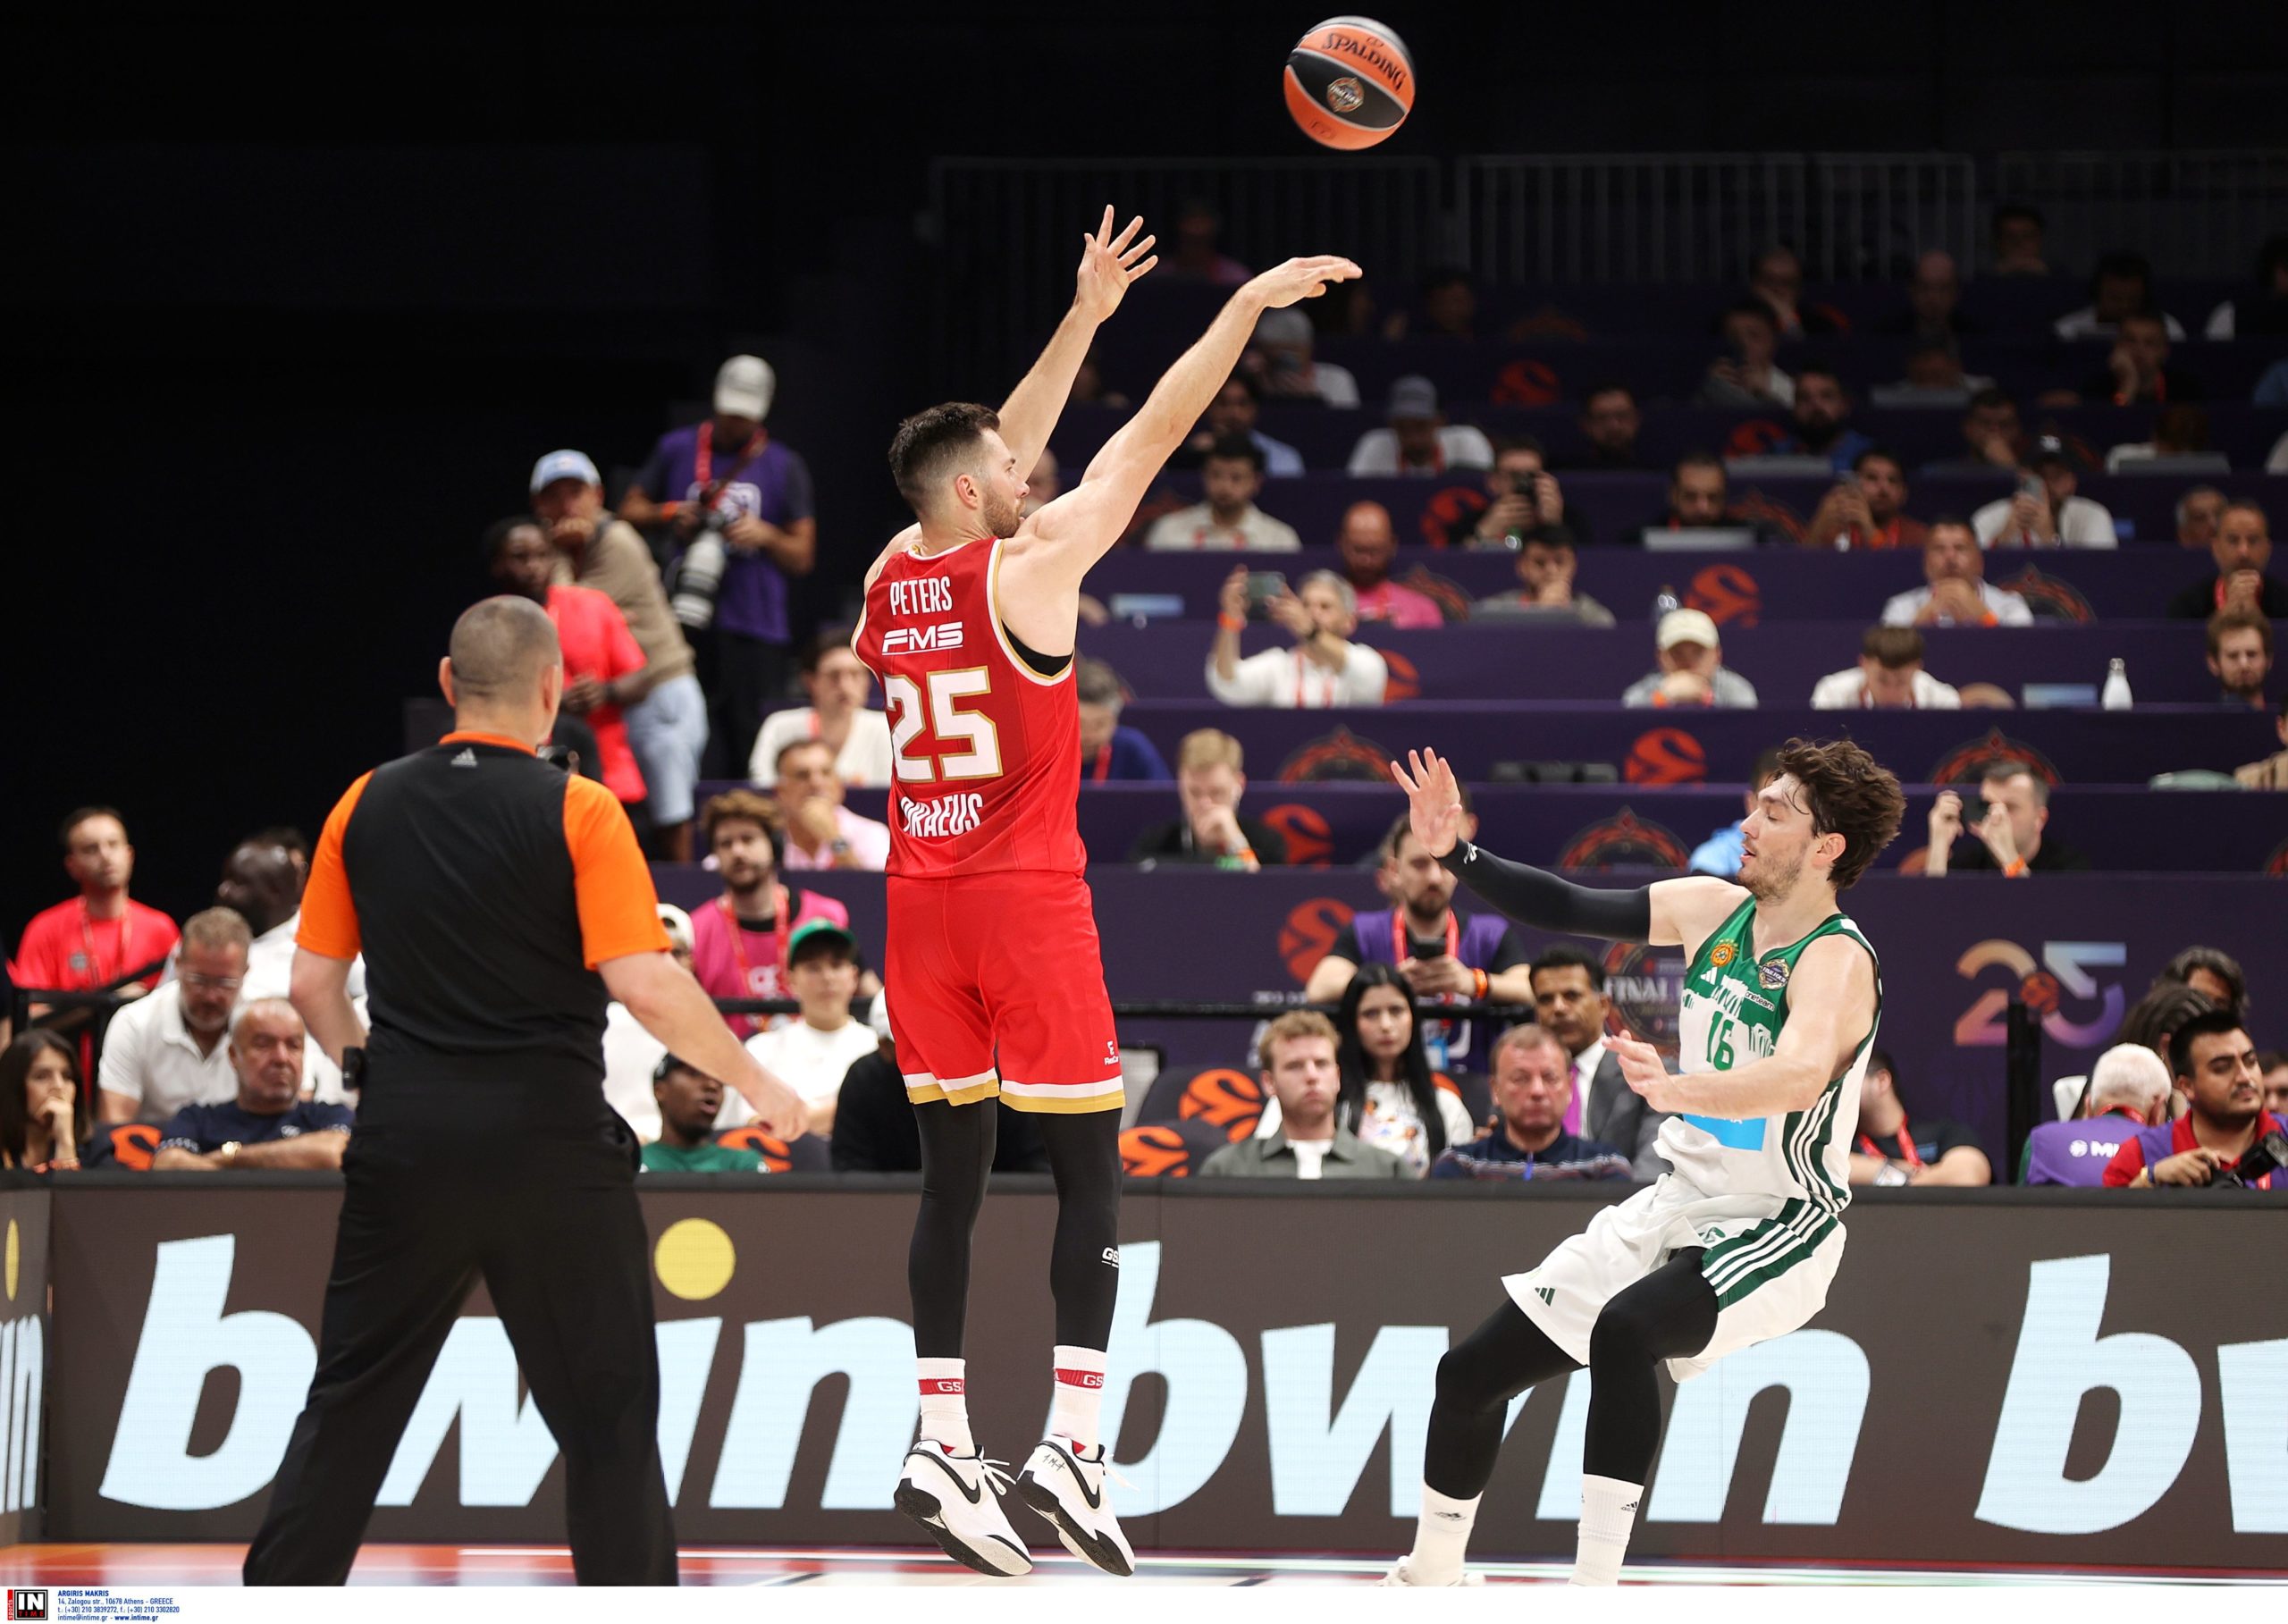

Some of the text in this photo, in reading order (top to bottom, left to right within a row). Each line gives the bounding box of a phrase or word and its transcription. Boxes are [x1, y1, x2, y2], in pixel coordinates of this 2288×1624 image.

[1322, 32, 1406, 92] SPALDING
[889, 576, 953, 615] PETERS
[882, 621, 963, 655] FMS
[883, 665, 1004, 783] 25
[1706, 1011, 1735, 1071] 16
[937, 1381, 964, 1393] GS
